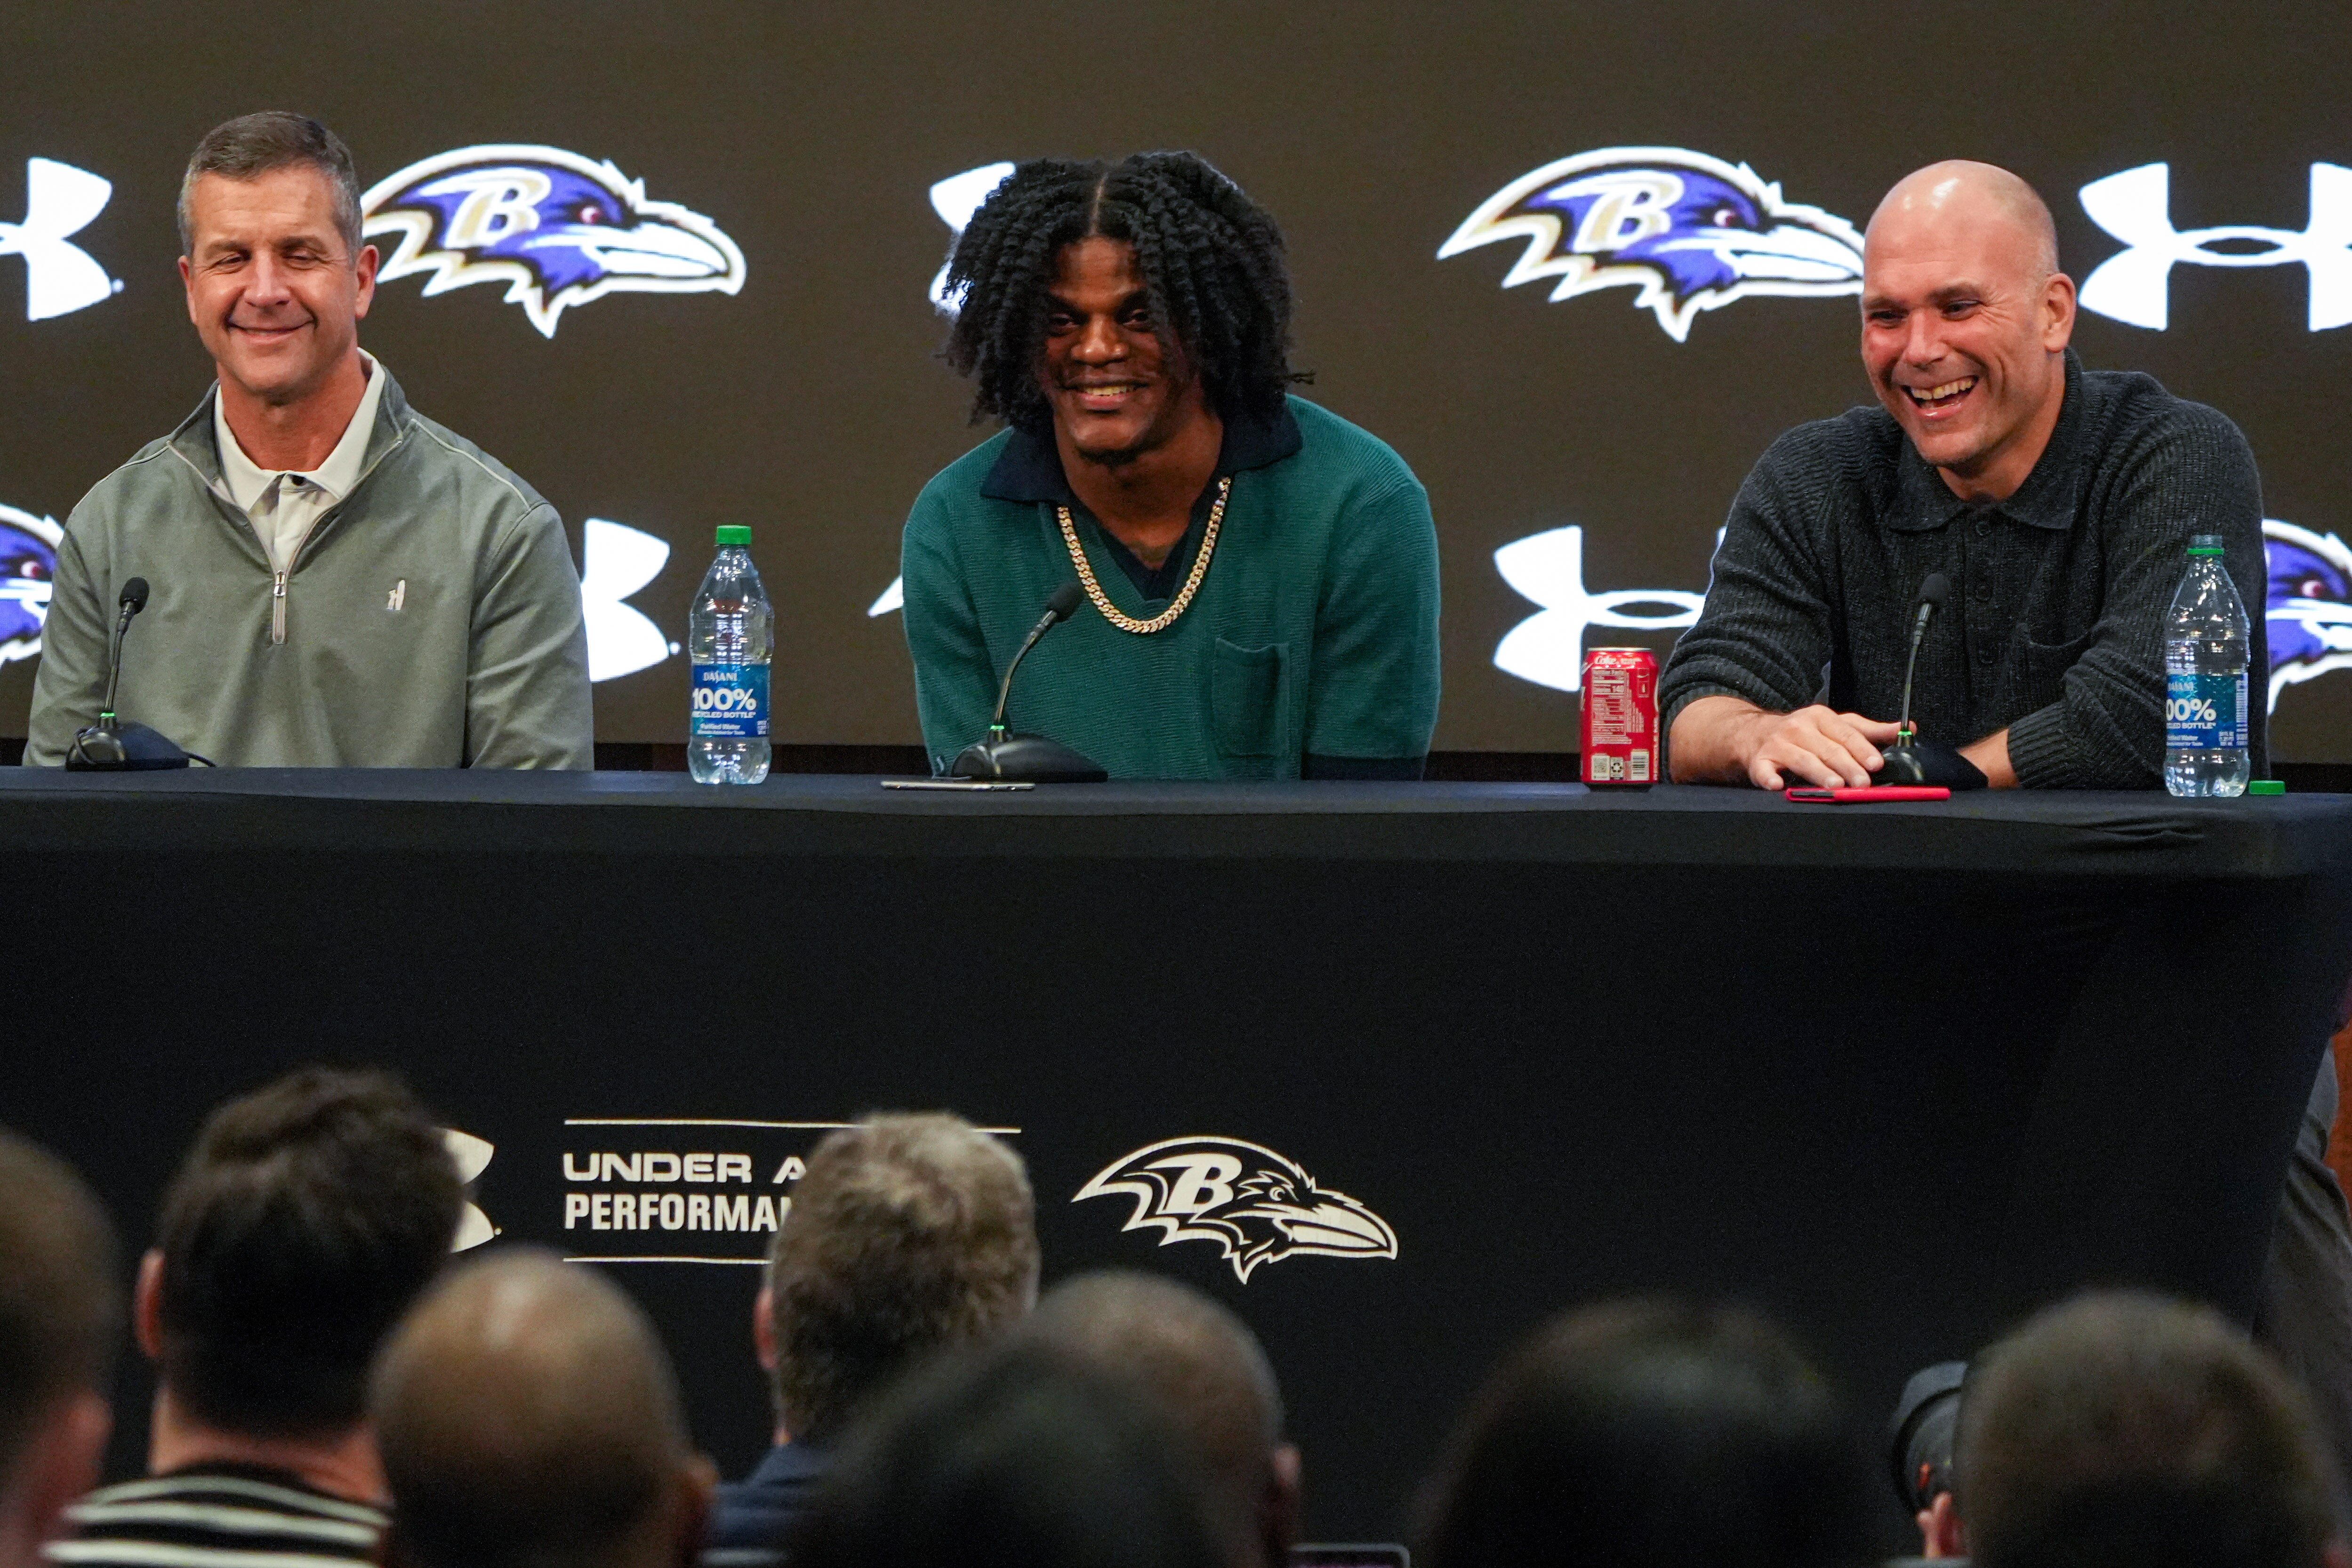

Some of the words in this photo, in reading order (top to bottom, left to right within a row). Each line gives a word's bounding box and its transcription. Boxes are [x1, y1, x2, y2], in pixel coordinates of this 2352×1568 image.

[703, 671, 738, 683] DASANI
[692, 688, 756, 710] 100%
[2166, 699, 2216, 721] 00%
[563, 1153, 752, 1182] UNDER
[565, 1194, 793, 1232] PERFORMA
